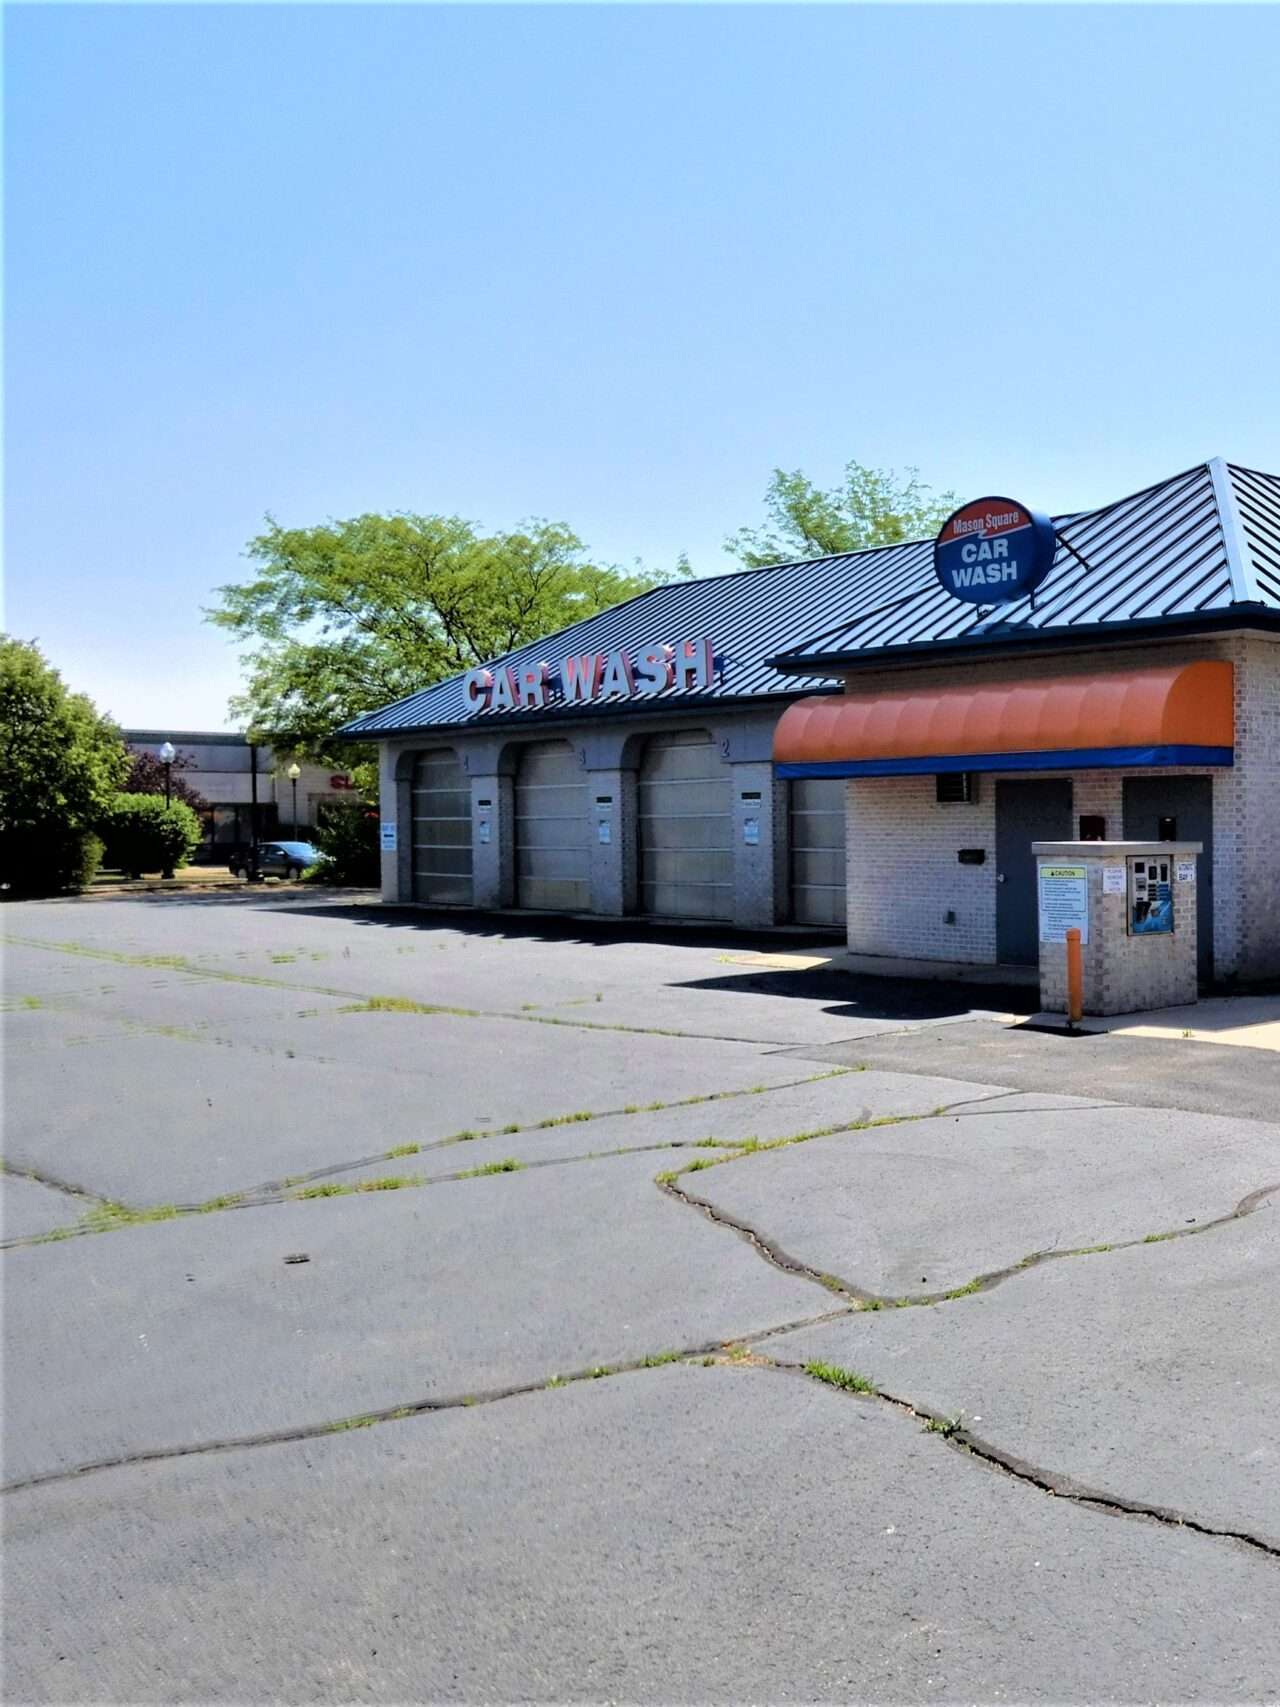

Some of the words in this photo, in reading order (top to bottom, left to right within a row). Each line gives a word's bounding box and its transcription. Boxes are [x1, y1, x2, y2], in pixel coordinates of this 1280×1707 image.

[953, 517, 984, 534] Mason
[985, 512, 1019, 530] Square
[961, 538, 1008, 563] CAR
[951, 560, 1017, 588] WASH
[462, 661, 552, 712] CAR
[559, 638, 714, 702] WASH
